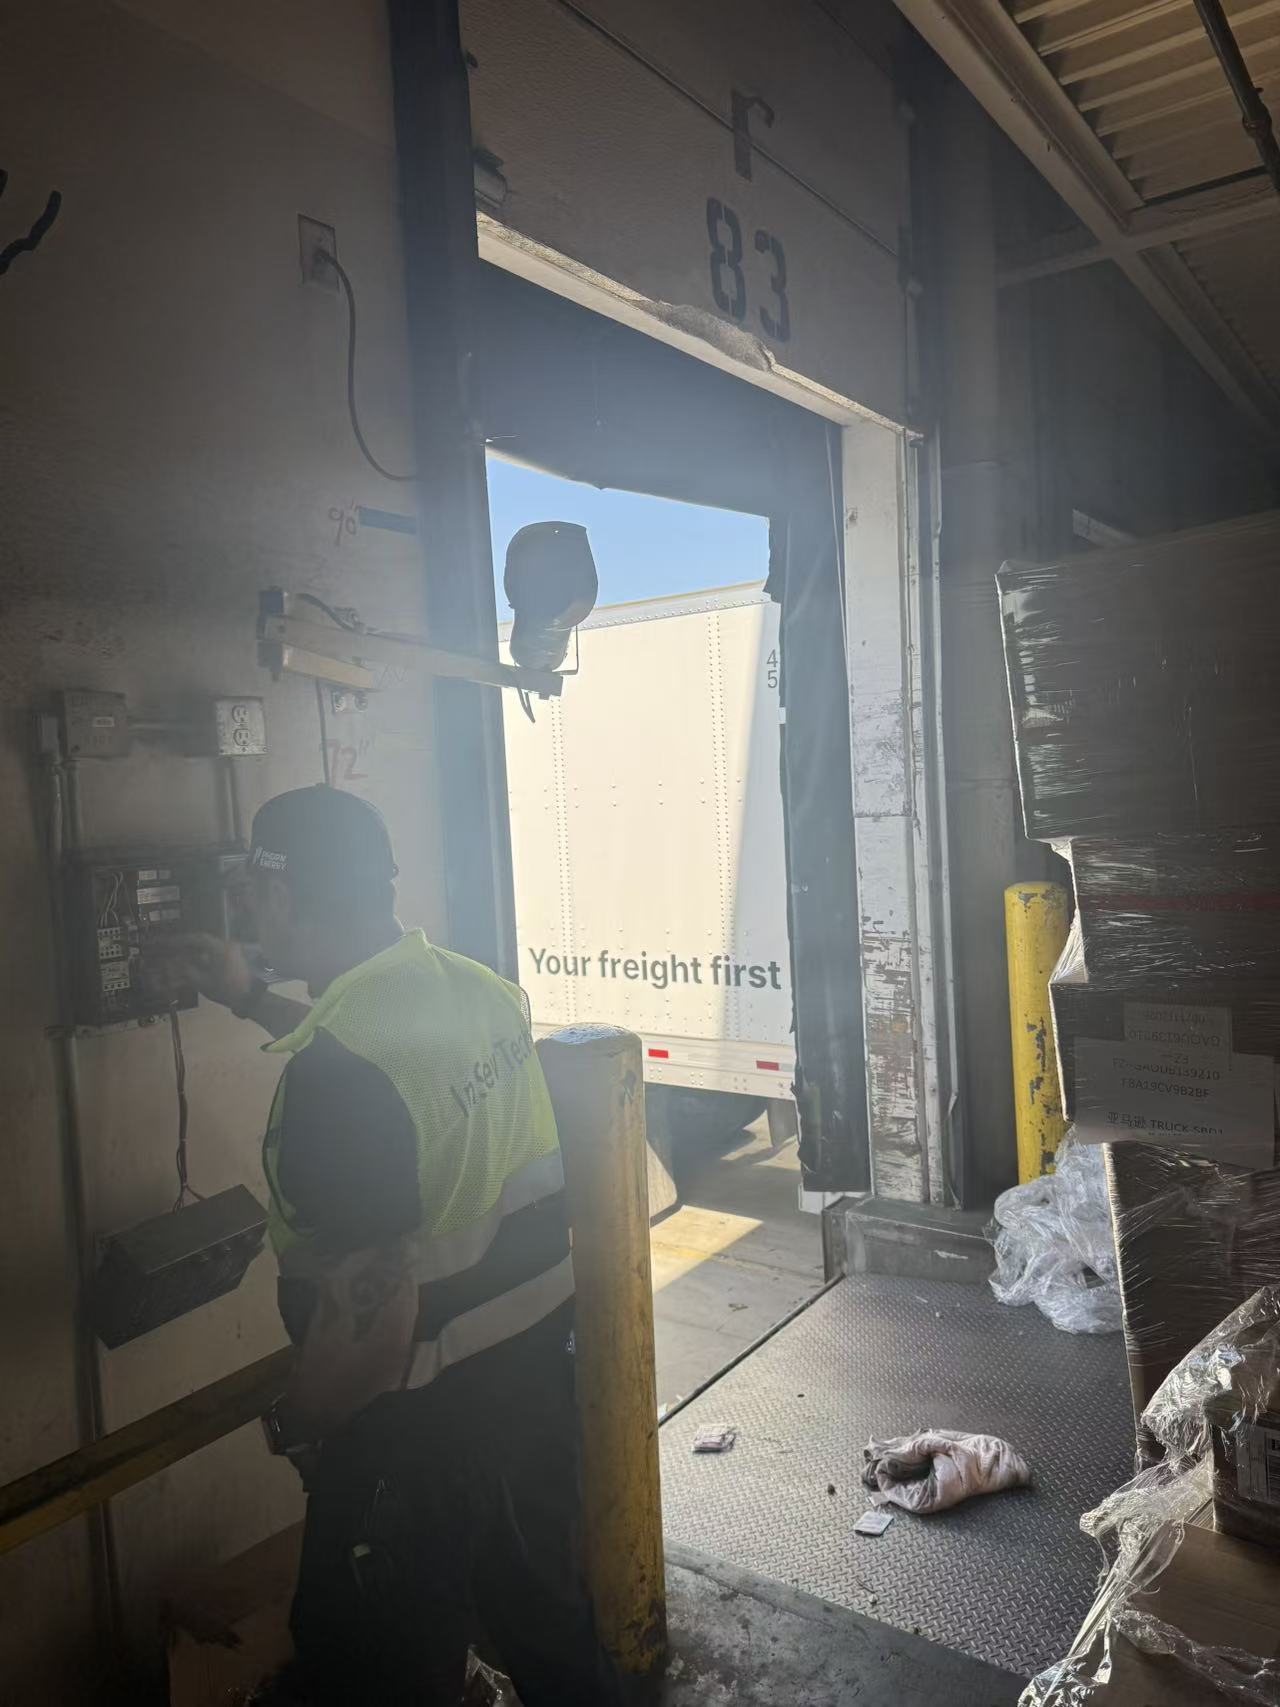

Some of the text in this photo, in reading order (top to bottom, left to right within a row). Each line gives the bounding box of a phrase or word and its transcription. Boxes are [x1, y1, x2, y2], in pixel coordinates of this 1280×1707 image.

[706, 196, 790, 342] 83
[529, 947, 781, 990] Your freight first
